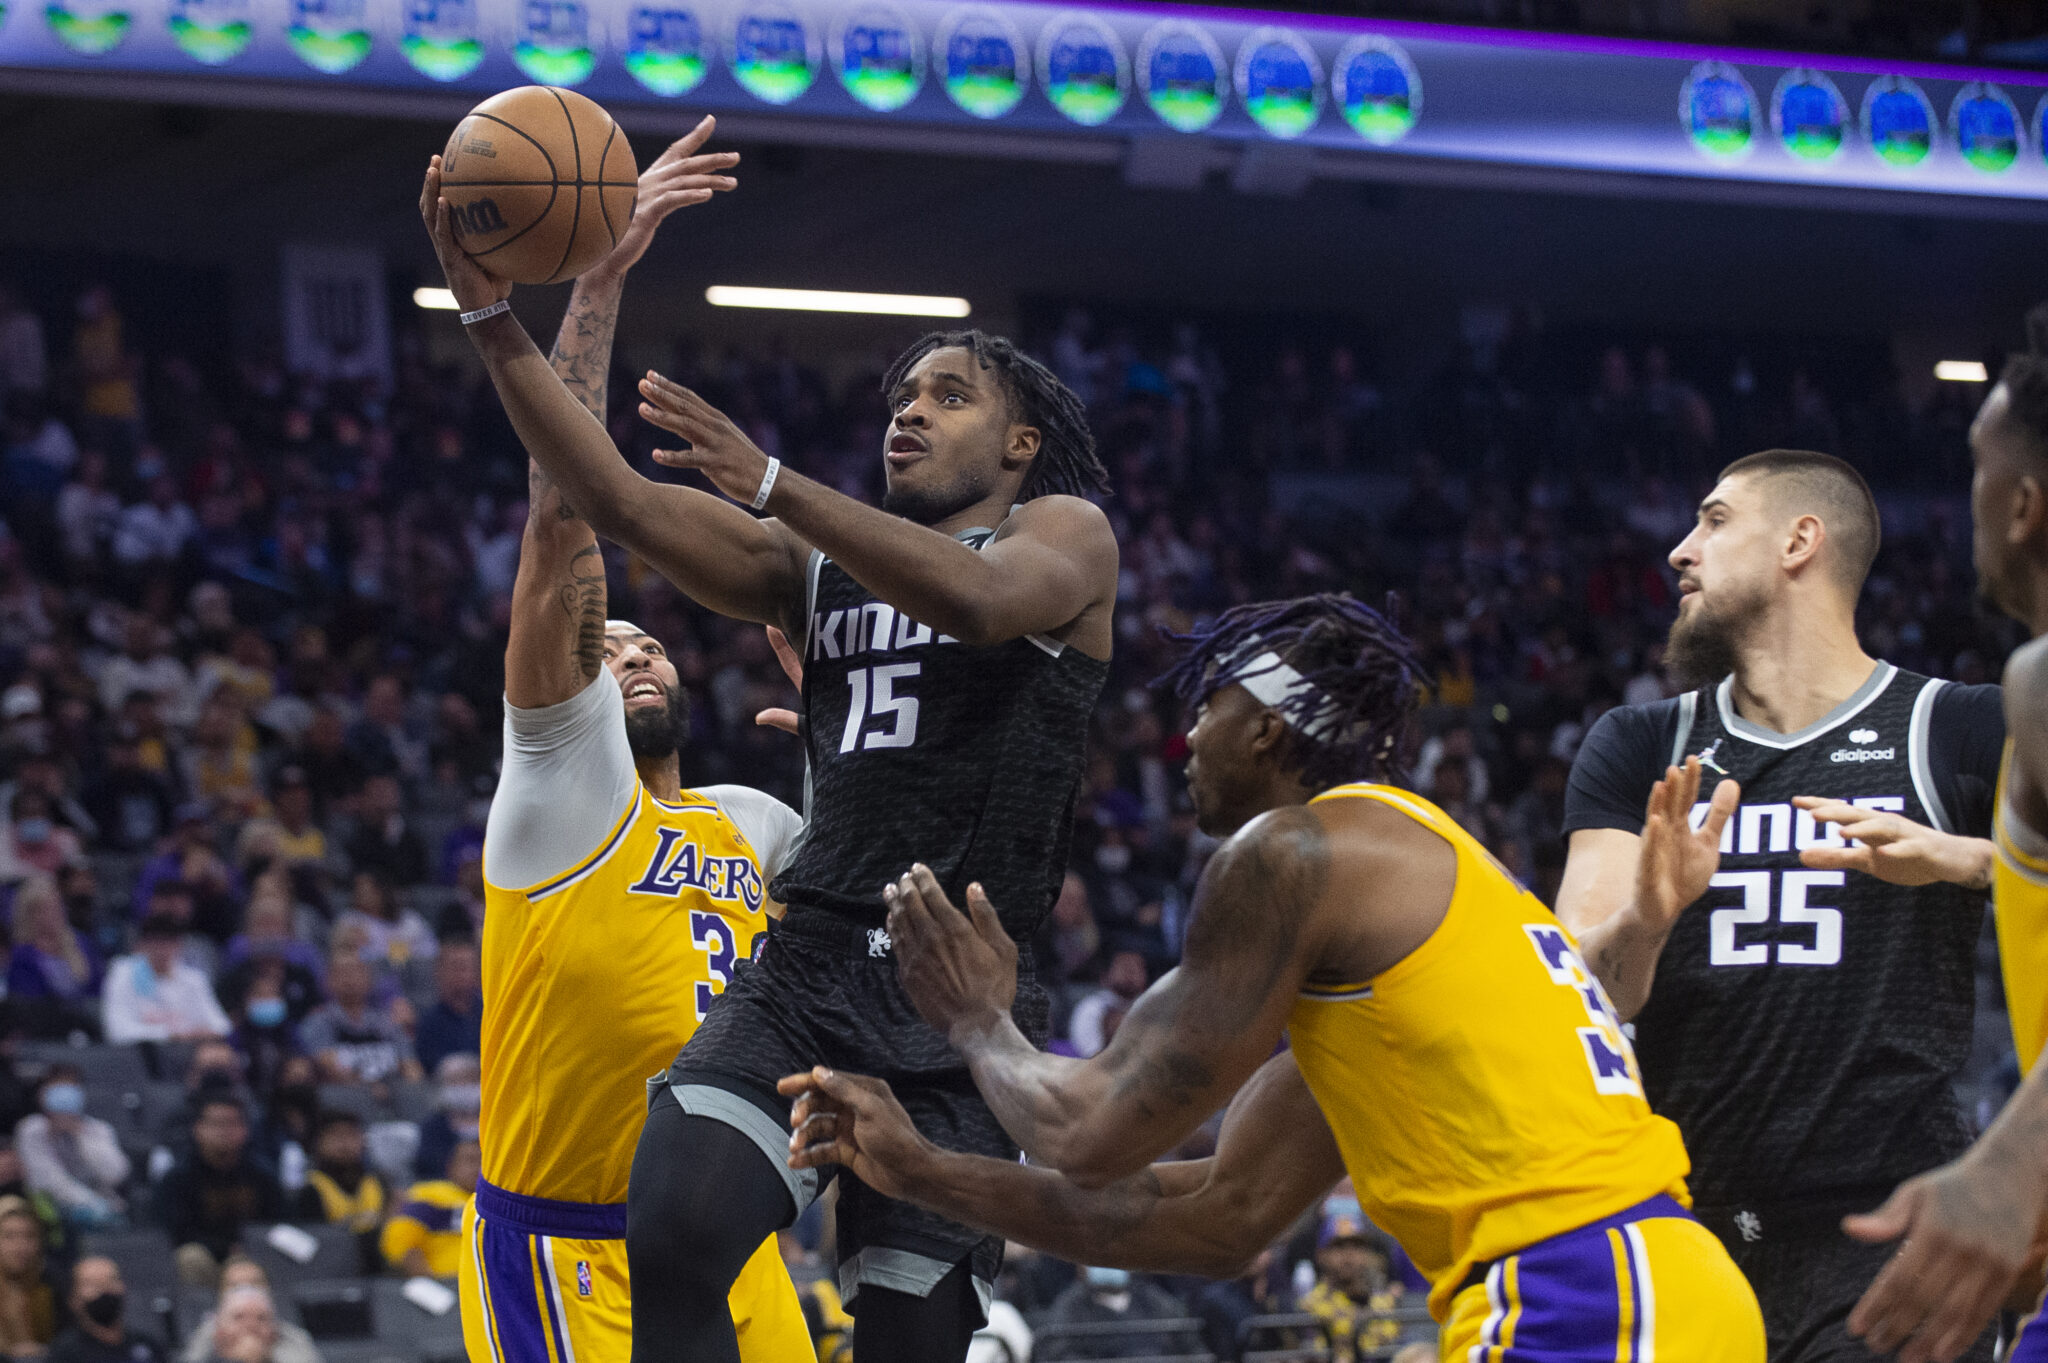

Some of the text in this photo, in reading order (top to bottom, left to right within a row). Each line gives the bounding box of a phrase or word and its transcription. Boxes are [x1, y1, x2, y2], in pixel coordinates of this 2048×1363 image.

[472, 308, 492, 320] OVER
[813, 602, 961, 662] KING
[840, 662, 920, 754] 15
[1830, 747, 1895, 763] dialpad
[626, 825, 764, 914] LAERS
[1709, 871, 1846, 966] 25
[689, 909, 737, 1022] 3
